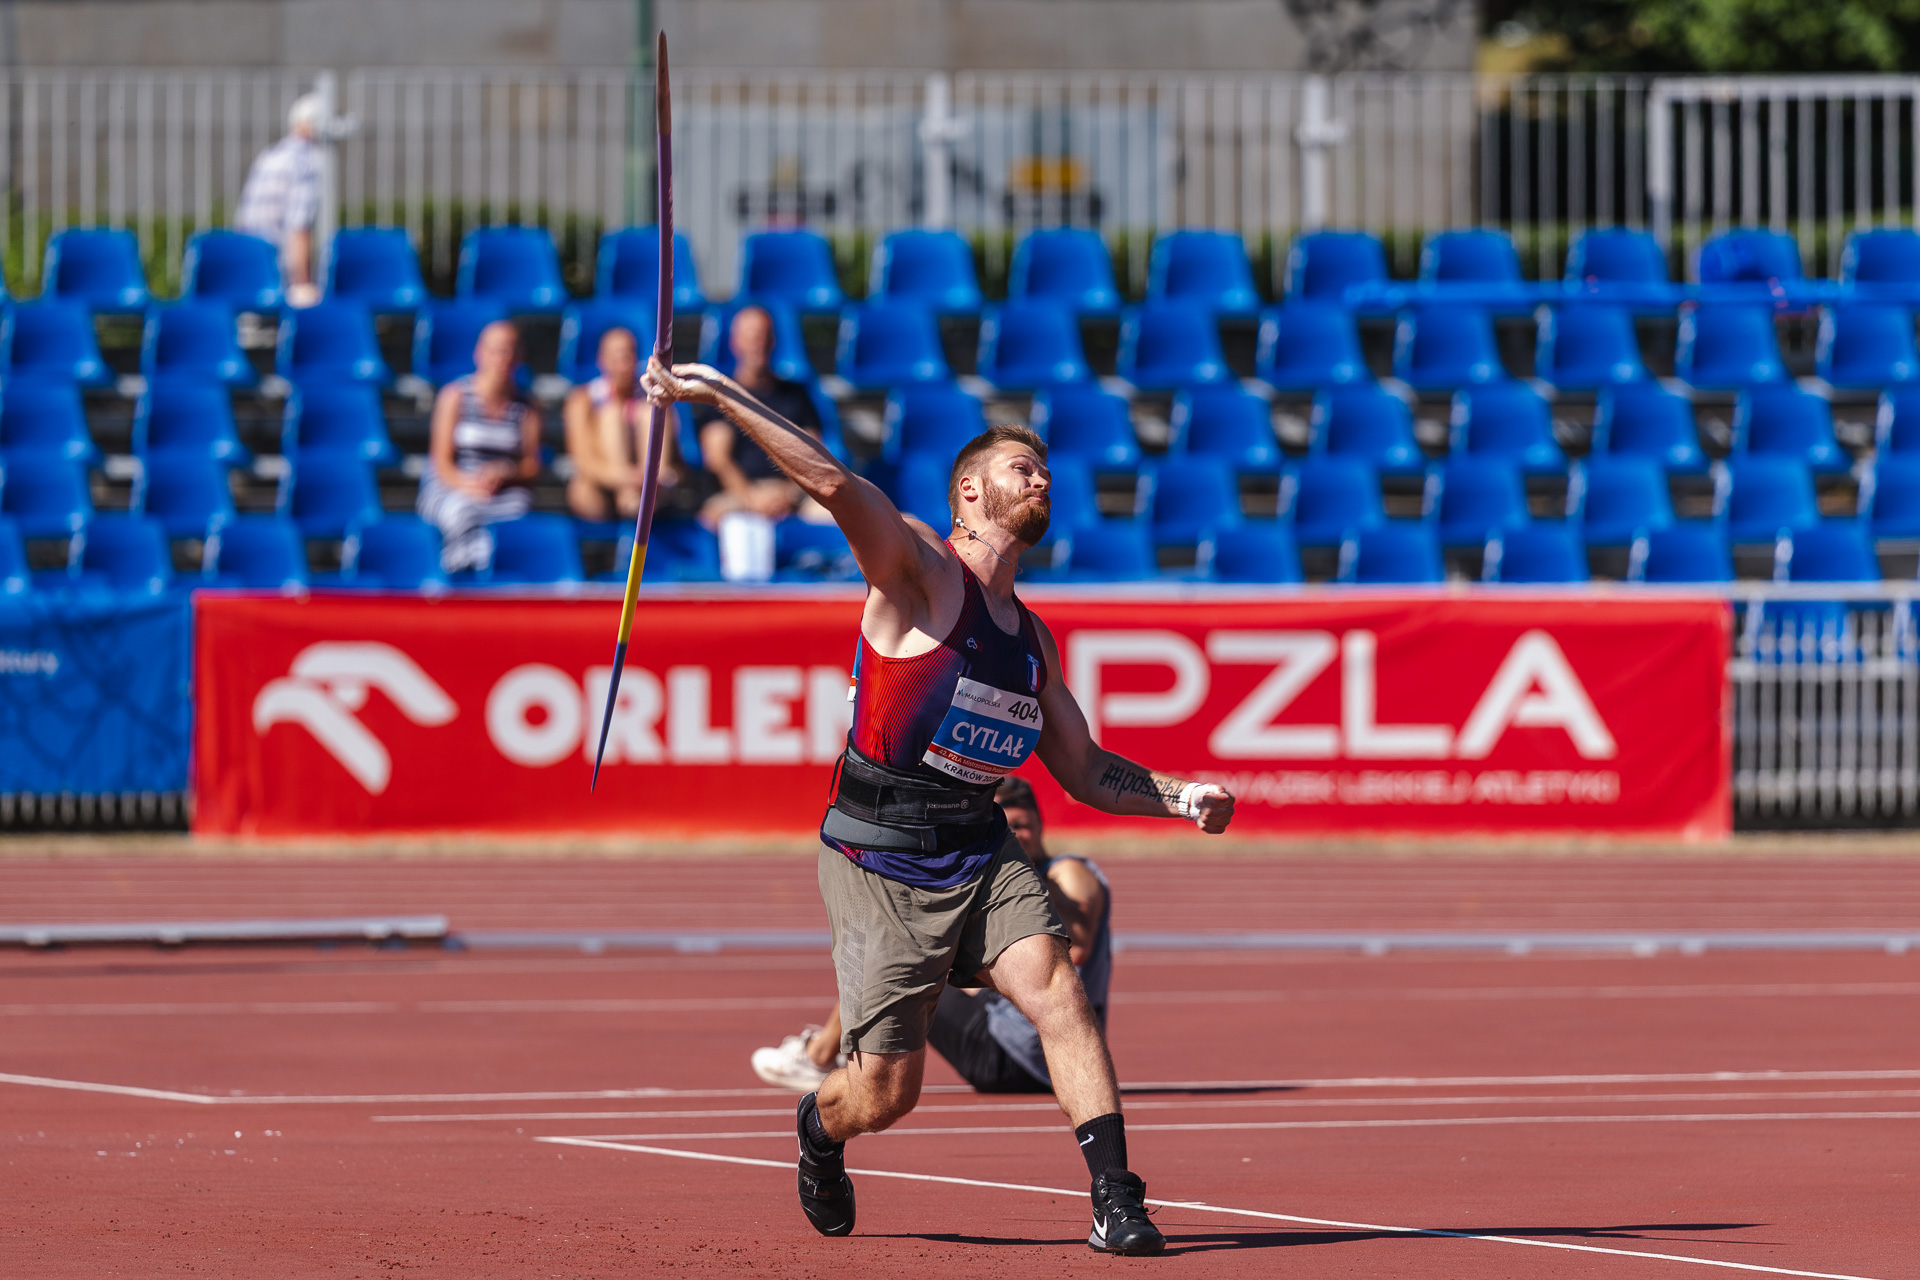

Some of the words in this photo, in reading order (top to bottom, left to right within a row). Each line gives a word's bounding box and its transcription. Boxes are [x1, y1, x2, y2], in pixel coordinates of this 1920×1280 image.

[965, 692, 1001, 708] MAŁOPOLSKA
[1068, 629, 1616, 760] PZLA
[1008, 700, 1039, 723] 404
[952, 721, 1025, 758] CYTLAŁ
[943, 762, 983, 782] KRAKÓW
